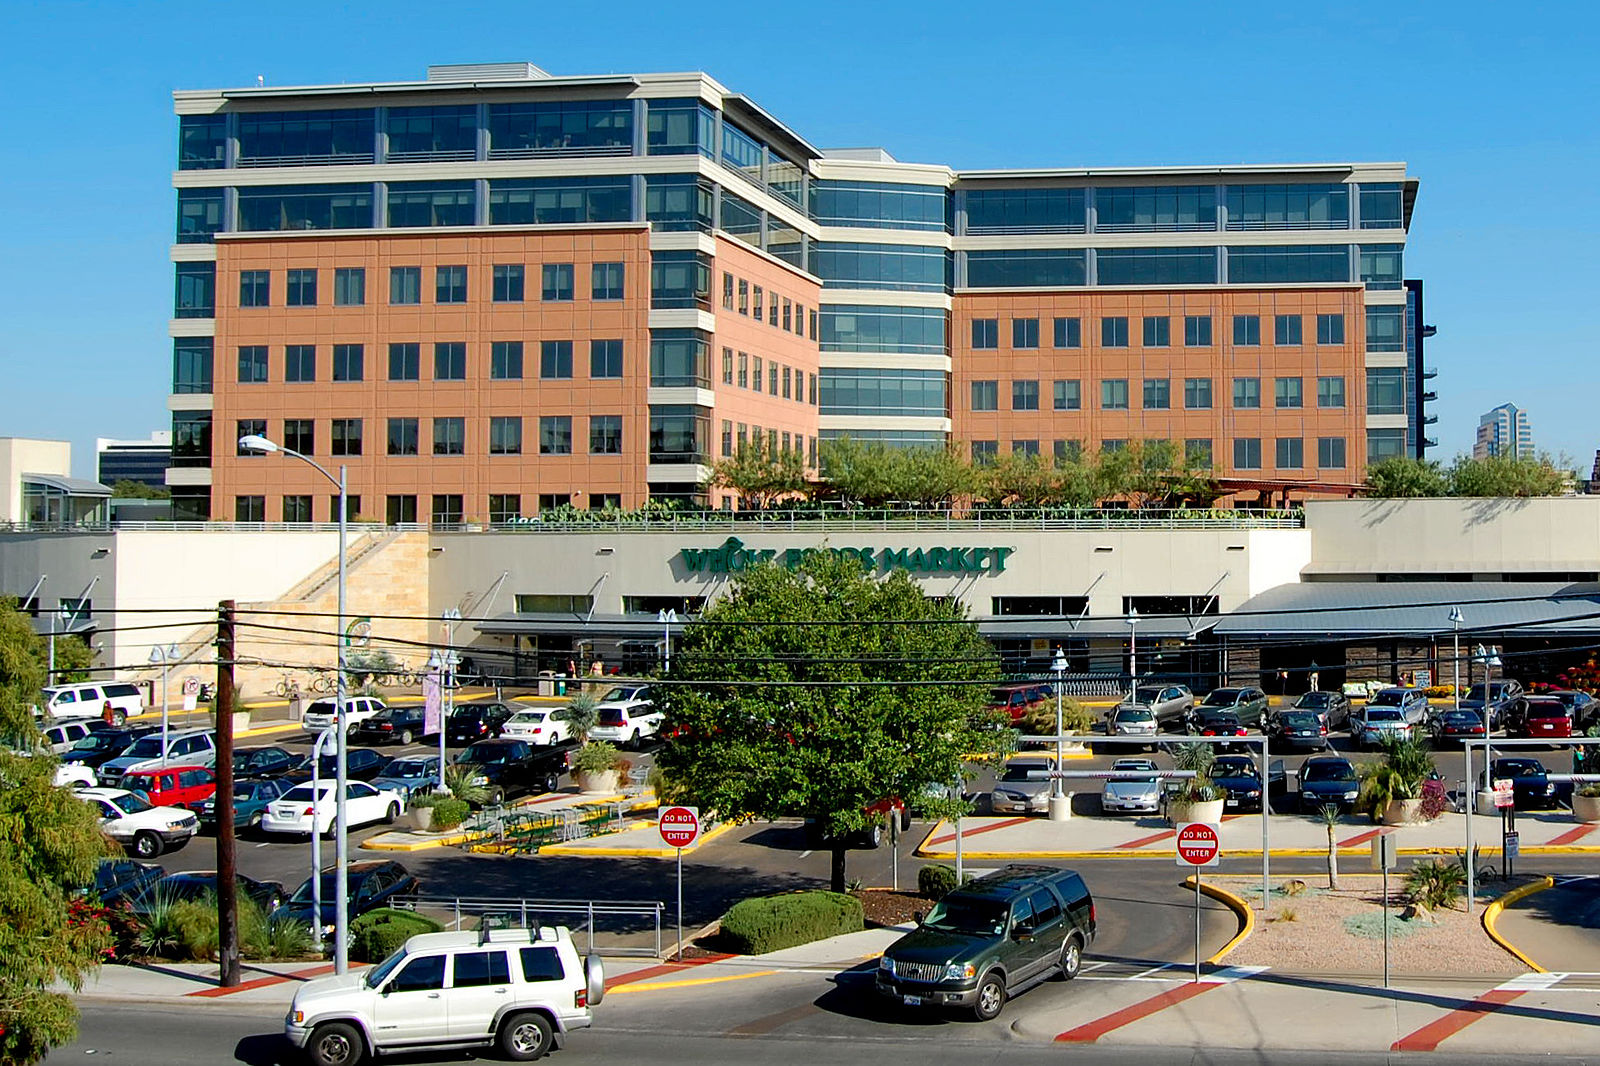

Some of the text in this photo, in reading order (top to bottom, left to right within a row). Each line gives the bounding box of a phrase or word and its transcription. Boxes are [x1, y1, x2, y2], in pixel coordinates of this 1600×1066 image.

[785, 547, 877, 572] FDS
[884, 547, 1011, 571] MARKET
[664, 814, 675, 822] DO
[667, 832, 690, 840] ENTER
[1183, 831, 1213, 839] DO NOT
[1185, 849, 1210, 857] ENTER
